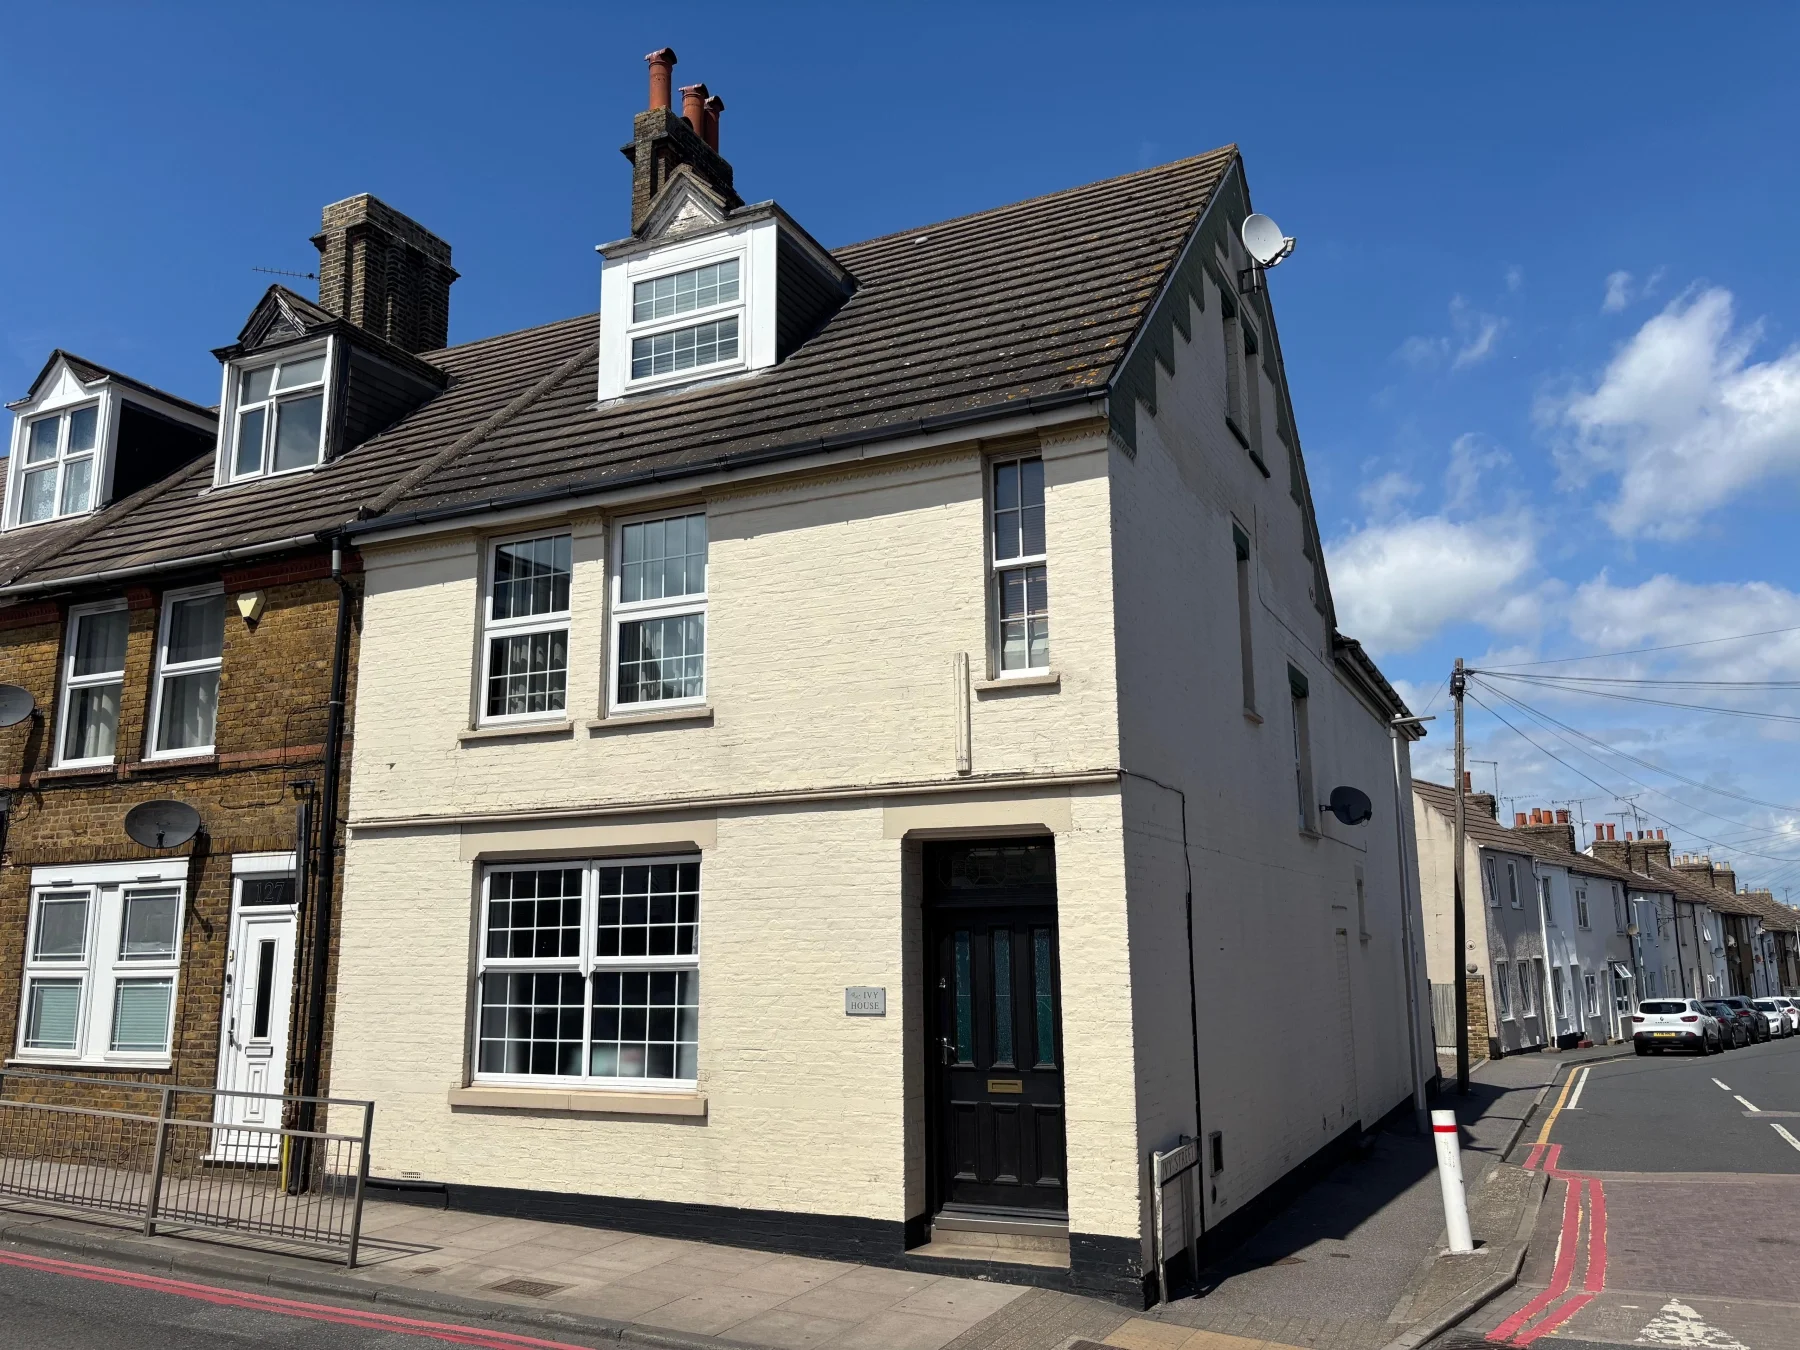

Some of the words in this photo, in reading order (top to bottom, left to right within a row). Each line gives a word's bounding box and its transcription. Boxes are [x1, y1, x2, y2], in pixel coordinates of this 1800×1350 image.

[256, 881, 285, 903] 127
[863, 991, 879, 999] IVY
[851, 1001, 880, 1010] HOUSE
[1174, 1144, 1195, 1171] STREET
